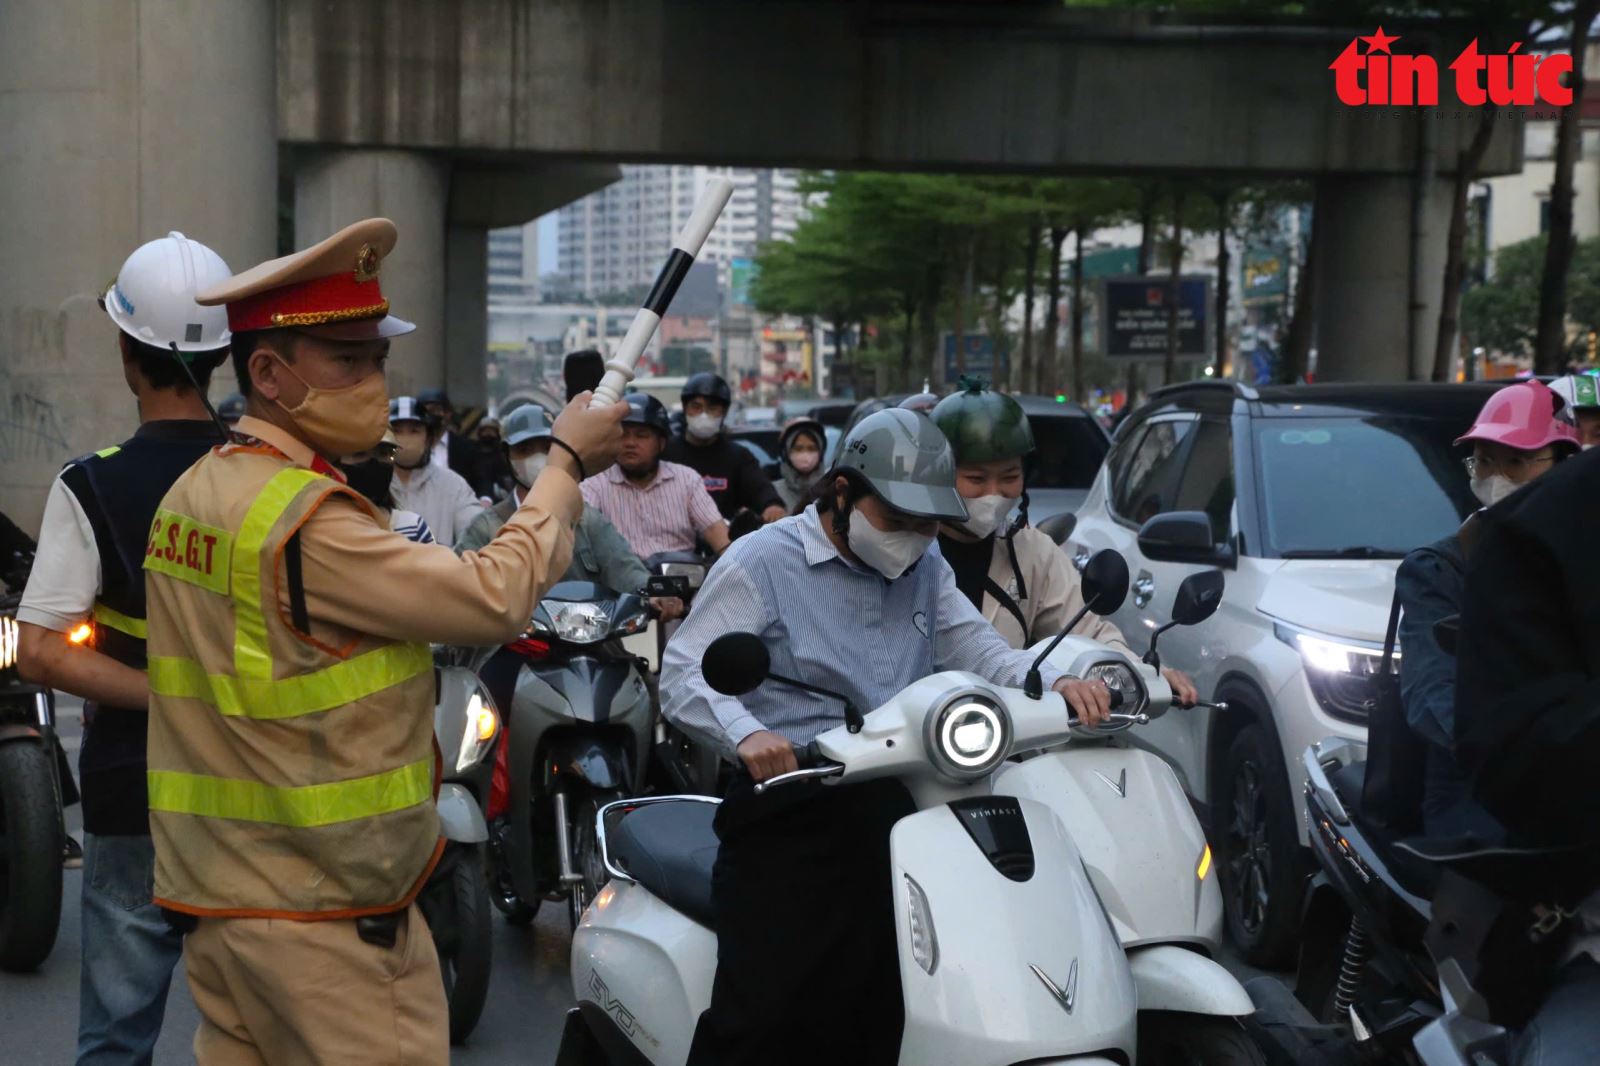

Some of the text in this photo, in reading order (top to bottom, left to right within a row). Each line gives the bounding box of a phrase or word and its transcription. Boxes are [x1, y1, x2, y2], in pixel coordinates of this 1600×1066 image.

[146, 518, 217, 576] C.S.G.T
[970, 807, 1017, 819] VINFAST
[589, 967, 636, 1037] EVO
